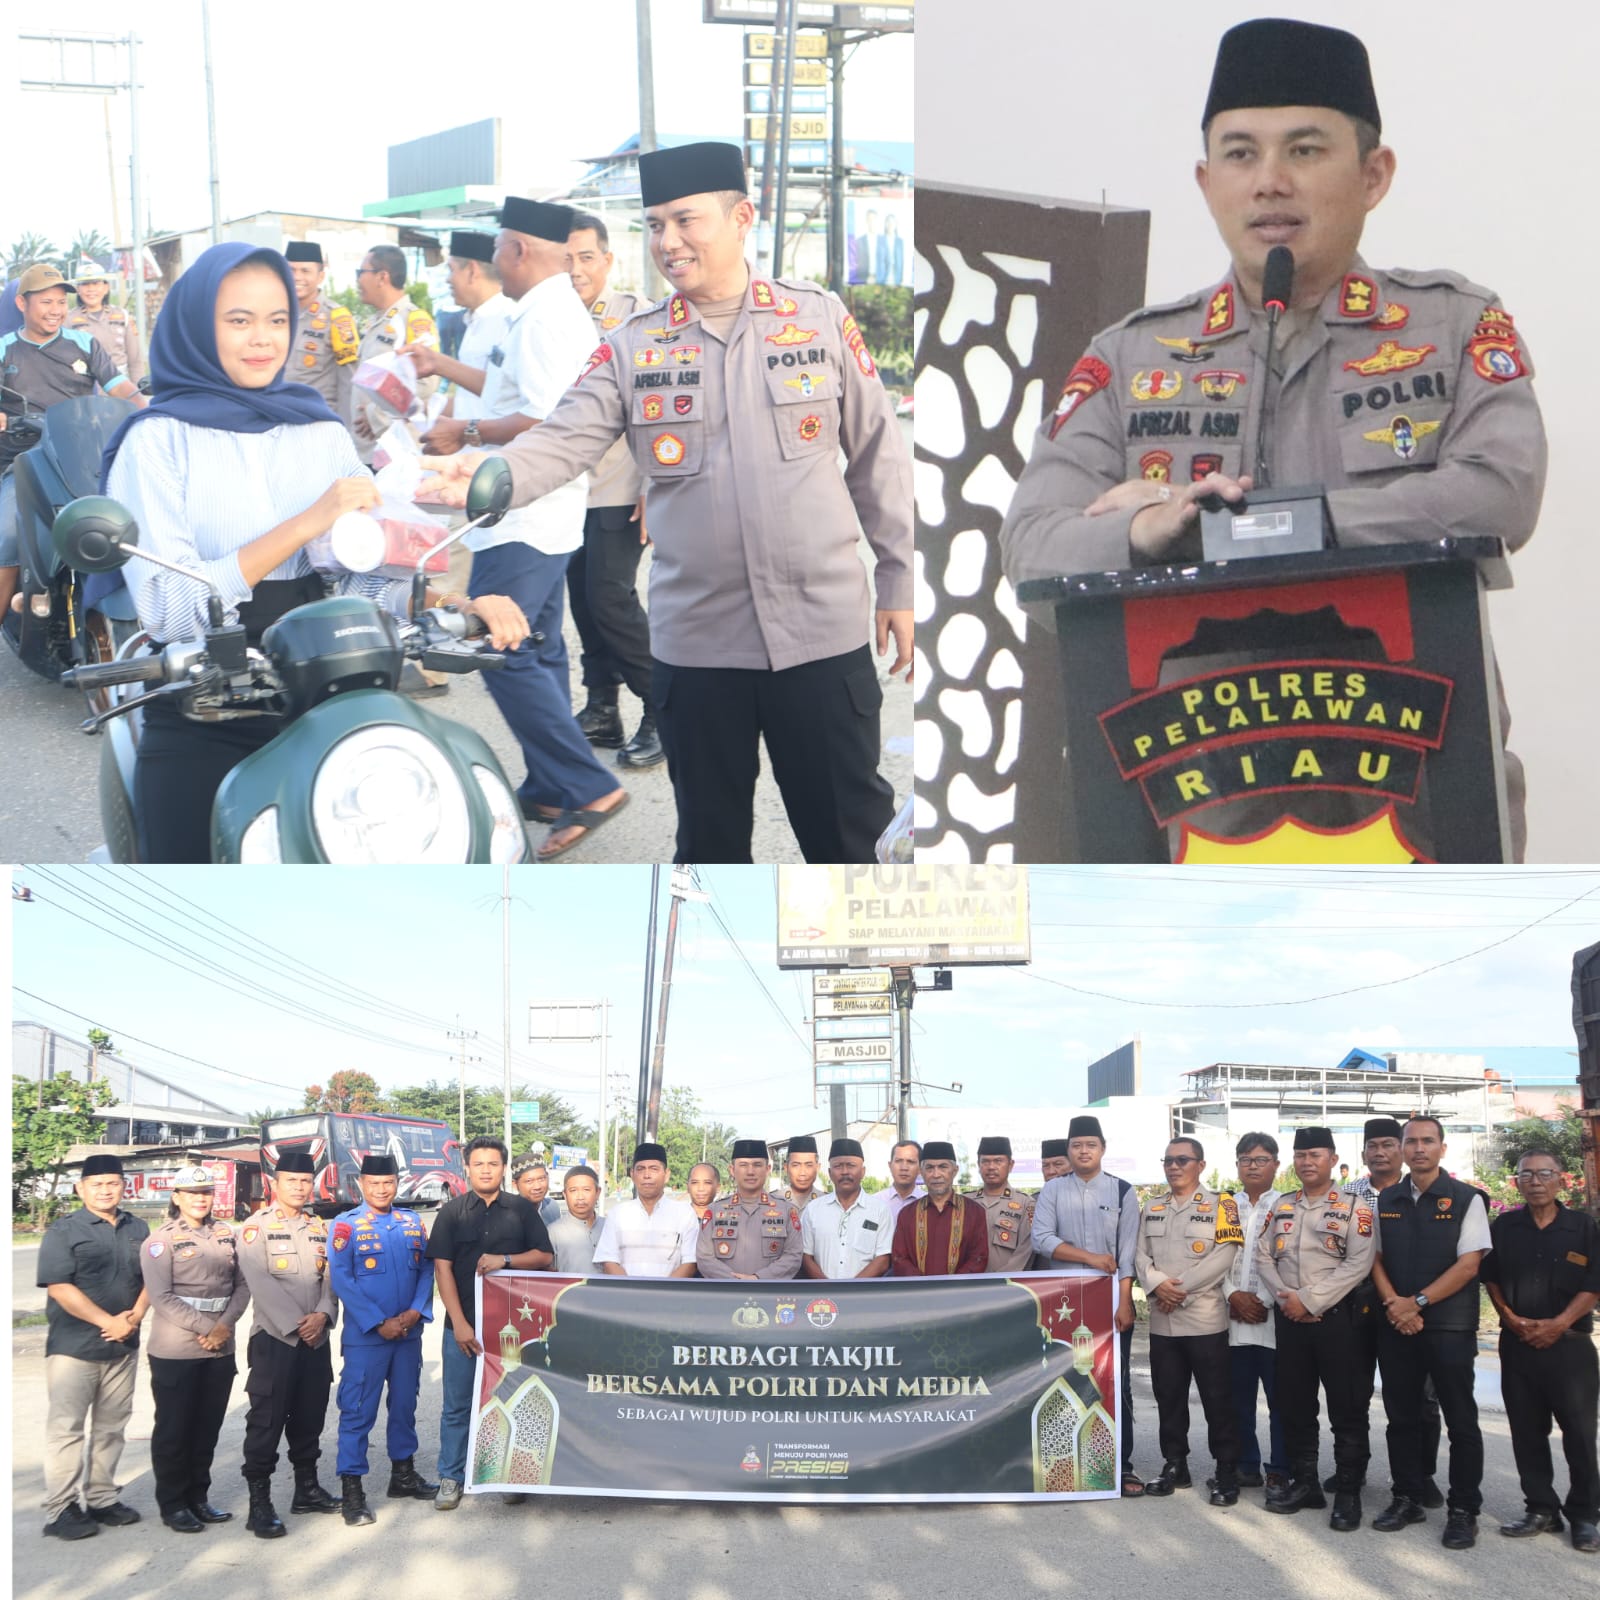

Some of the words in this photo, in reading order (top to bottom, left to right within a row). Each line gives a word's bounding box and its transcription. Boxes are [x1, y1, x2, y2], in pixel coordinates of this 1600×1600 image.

[767, 348, 825, 370] POLRI
[1342, 371, 1446, 418] POLRI
[1182, 671, 1367, 715] POLRES
[1133, 699, 1423, 758] PELALAWAN
[1175, 748, 1391, 802] RIAU
[844, 864, 1019, 895] POLRES
[848, 896, 1017, 919] PELALAWAN
[848, 928, 875, 940] SIAP
[879, 927, 936, 939] MELAYANI
[834, 1045, 887, 1057] MASJID
[1190, 1215, 1214, 1223] POLRI
[1323, 1211, 1350, 1222] POLRI
[671, 1345, 799, 1367] BERBAGI
[805, 1346, 902, 1372] TAKJIL
[586, 1374, 718, 1396] BERSAMA
[728, 1376, 818, 1397] POLRI
[827, 1376, 894, 1397] DAN
[896, 1376, 992, 1396] MEDIA
[616, 1407, 685, 1422] SEBAGAI
[689, 1408, 746, 1424] WUJUD
[751, 1410, 799, 1424] POLRI
[805, 1411, 864, 1424] UNTUK
[867, 1409, 977, 1424] MASYARAKAT
[770, 1460, 850, 1474] PRESISI
